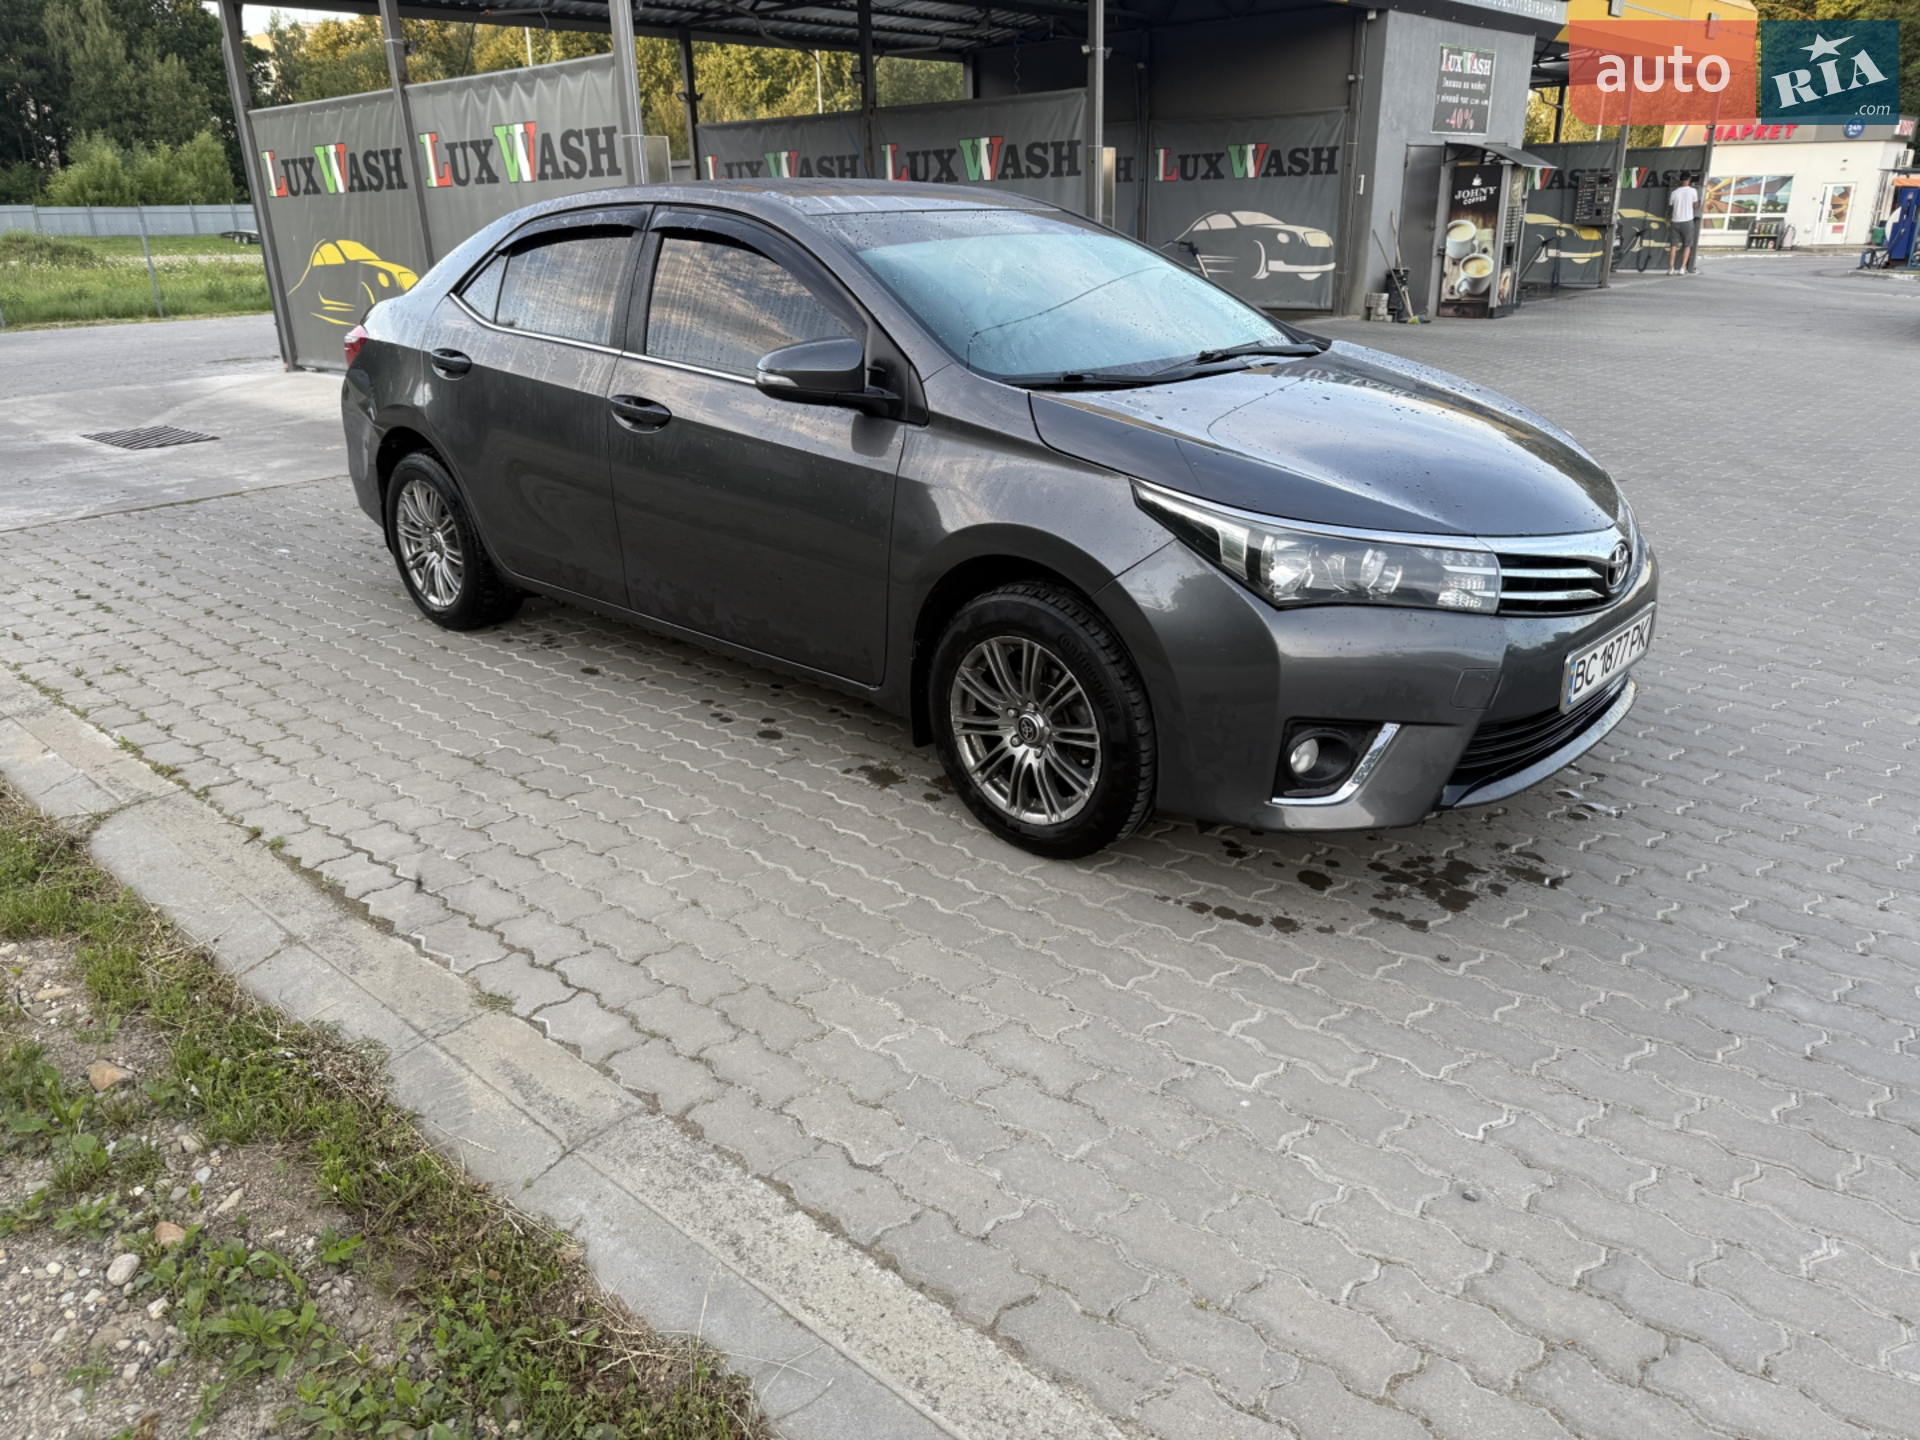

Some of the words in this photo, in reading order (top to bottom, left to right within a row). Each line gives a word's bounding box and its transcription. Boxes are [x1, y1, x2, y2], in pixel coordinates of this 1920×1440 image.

[1445, 108, 1475, 130] -40%
[1454, 186, 1498, 200] JOHNY
[1573, 652, 1598, 696] BC
[1600, 630, 1631, 678] 1877
